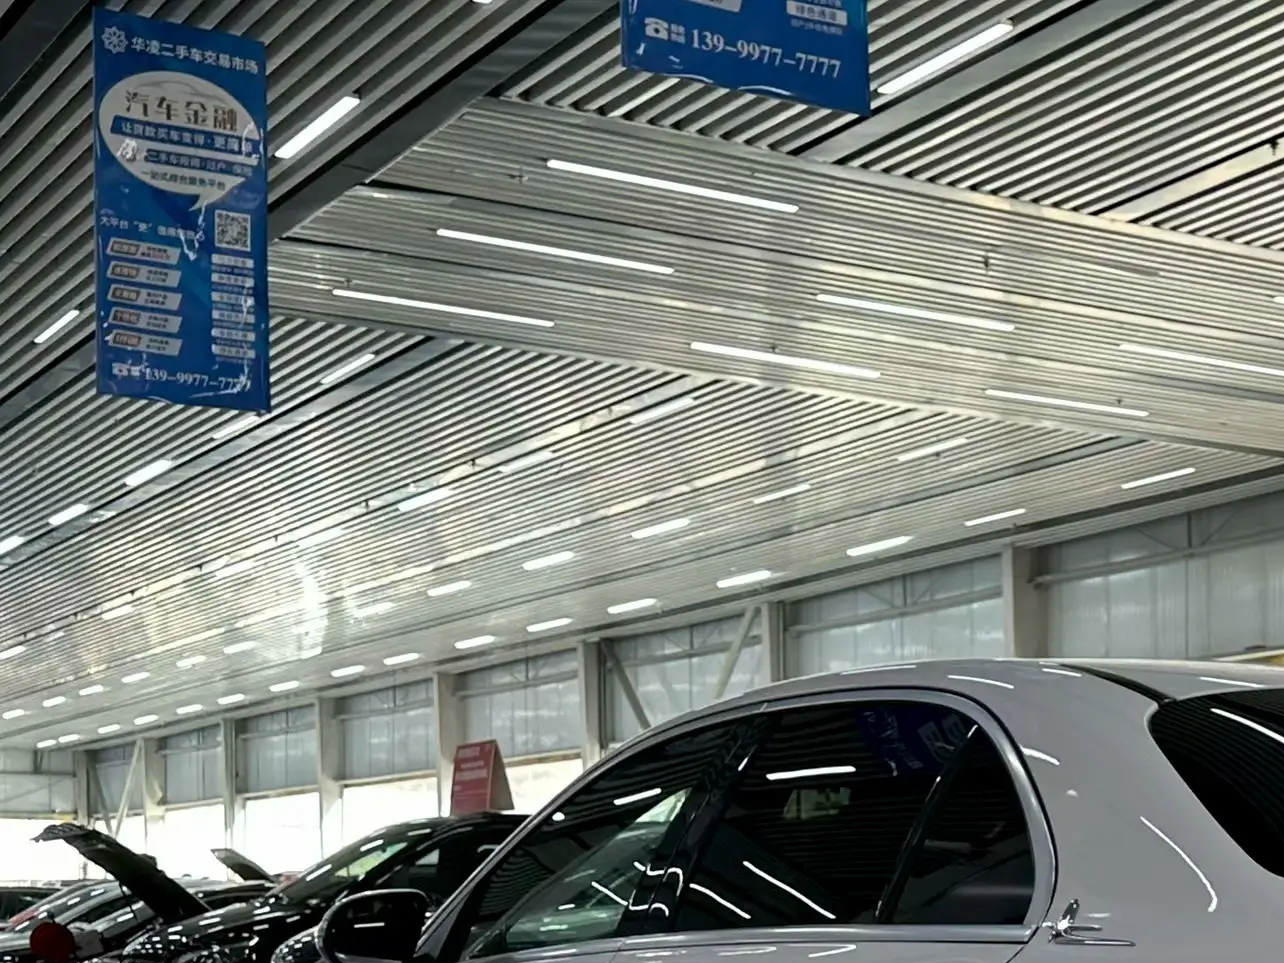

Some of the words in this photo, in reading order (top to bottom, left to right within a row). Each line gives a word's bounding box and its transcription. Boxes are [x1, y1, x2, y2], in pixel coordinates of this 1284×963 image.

[131, 36, 258, 74] 华凌二手车交易市场
[691, 30, 842, 79] 139-9977-7777
[124, 90, 238, 131] 汽车金融
